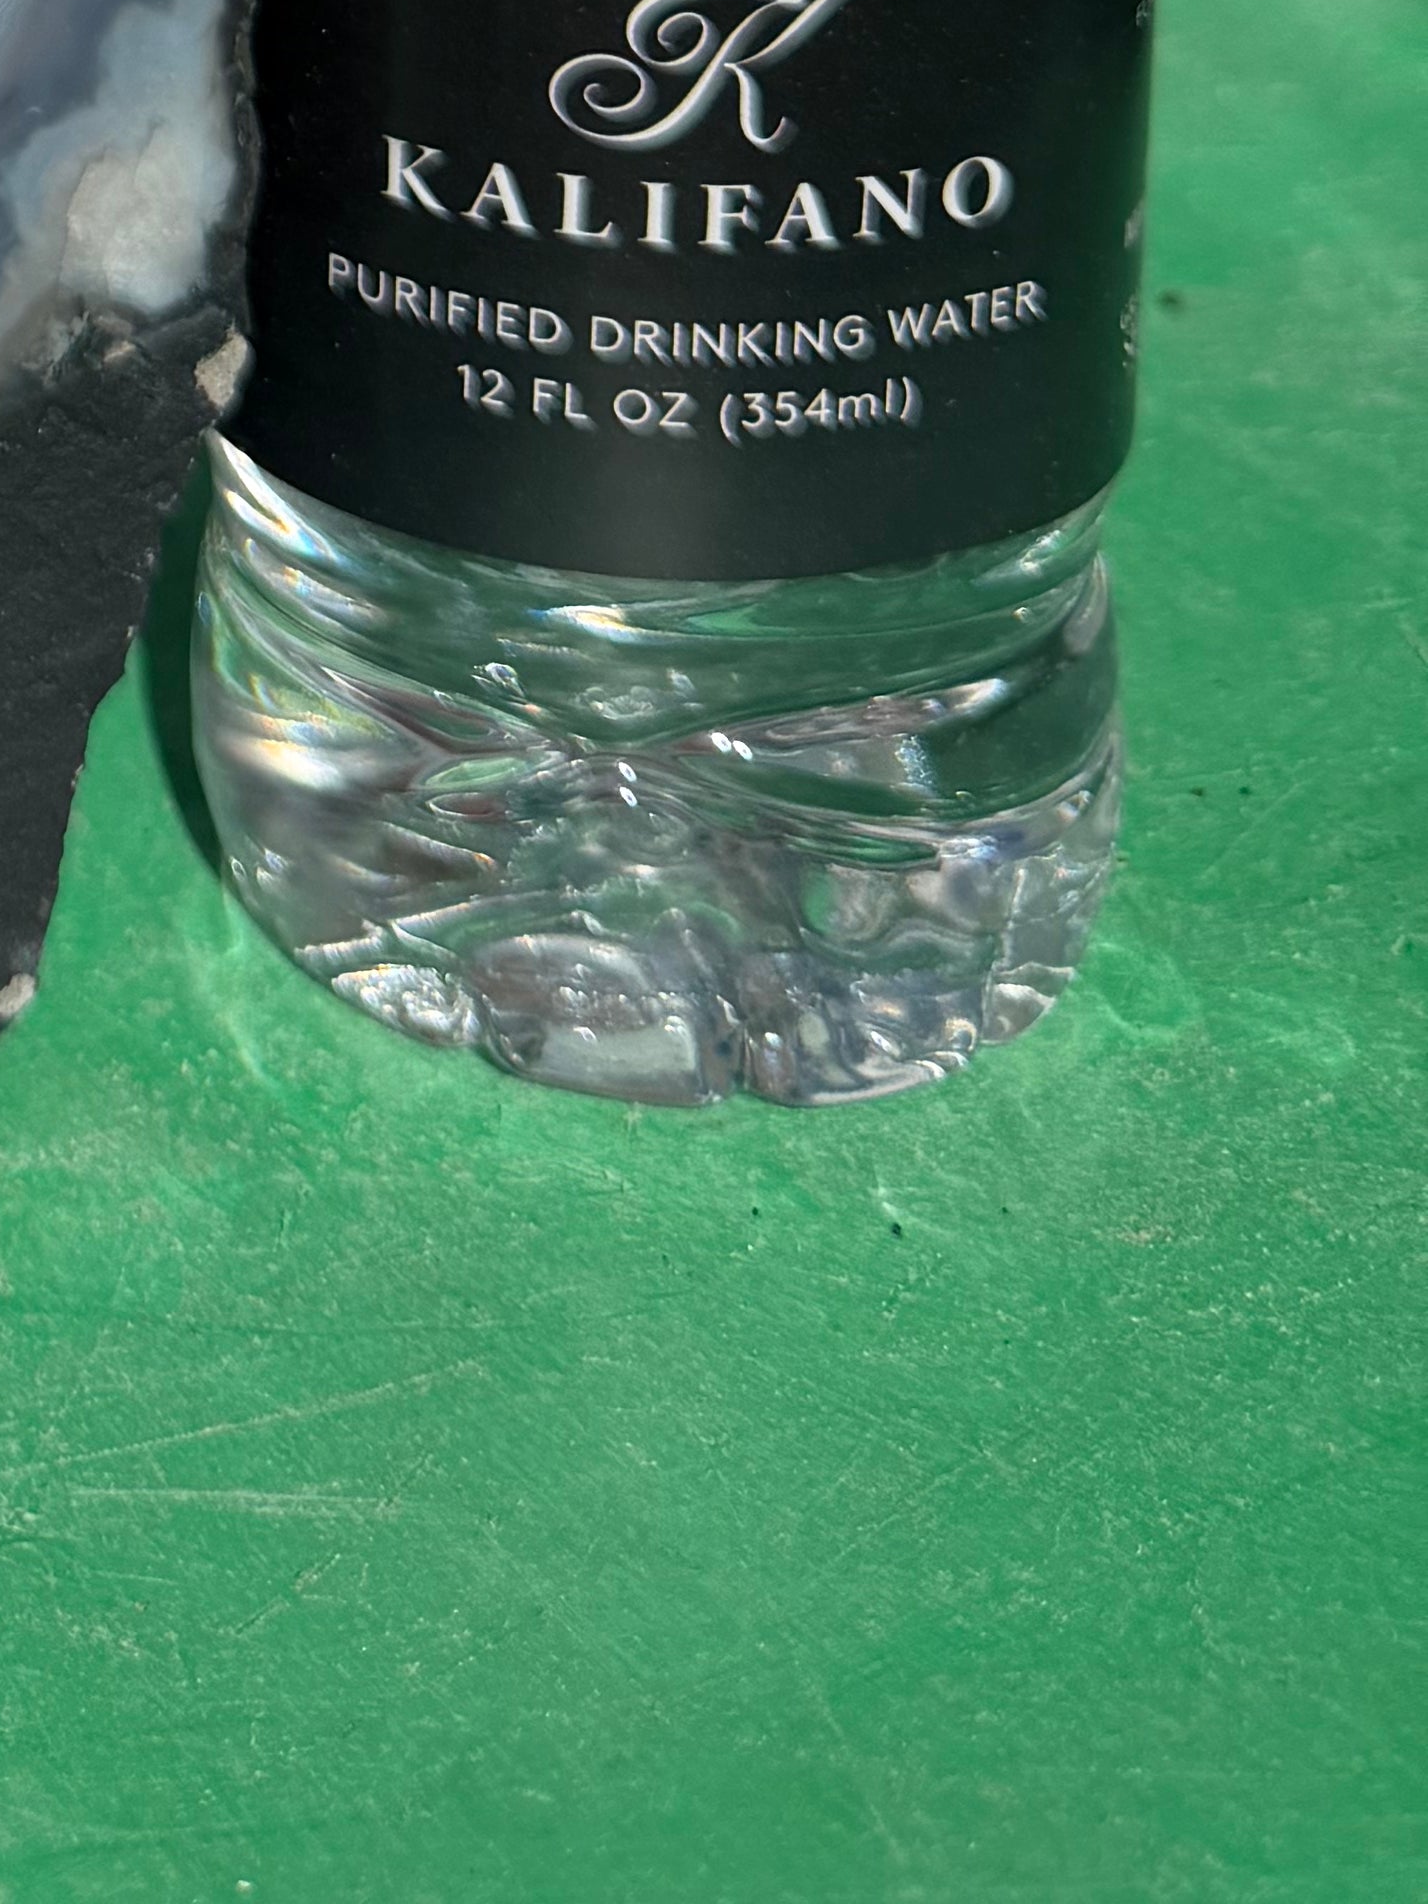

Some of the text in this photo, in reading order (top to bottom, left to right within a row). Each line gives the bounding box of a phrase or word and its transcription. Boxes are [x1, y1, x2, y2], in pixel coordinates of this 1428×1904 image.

[380, 133, 1016, 256] KALIFANO
[327, 252, 1048, 368] PURIFIED DRINKING WATER
[456, 362, 926, 448] 12 FL OZ (354ml)
